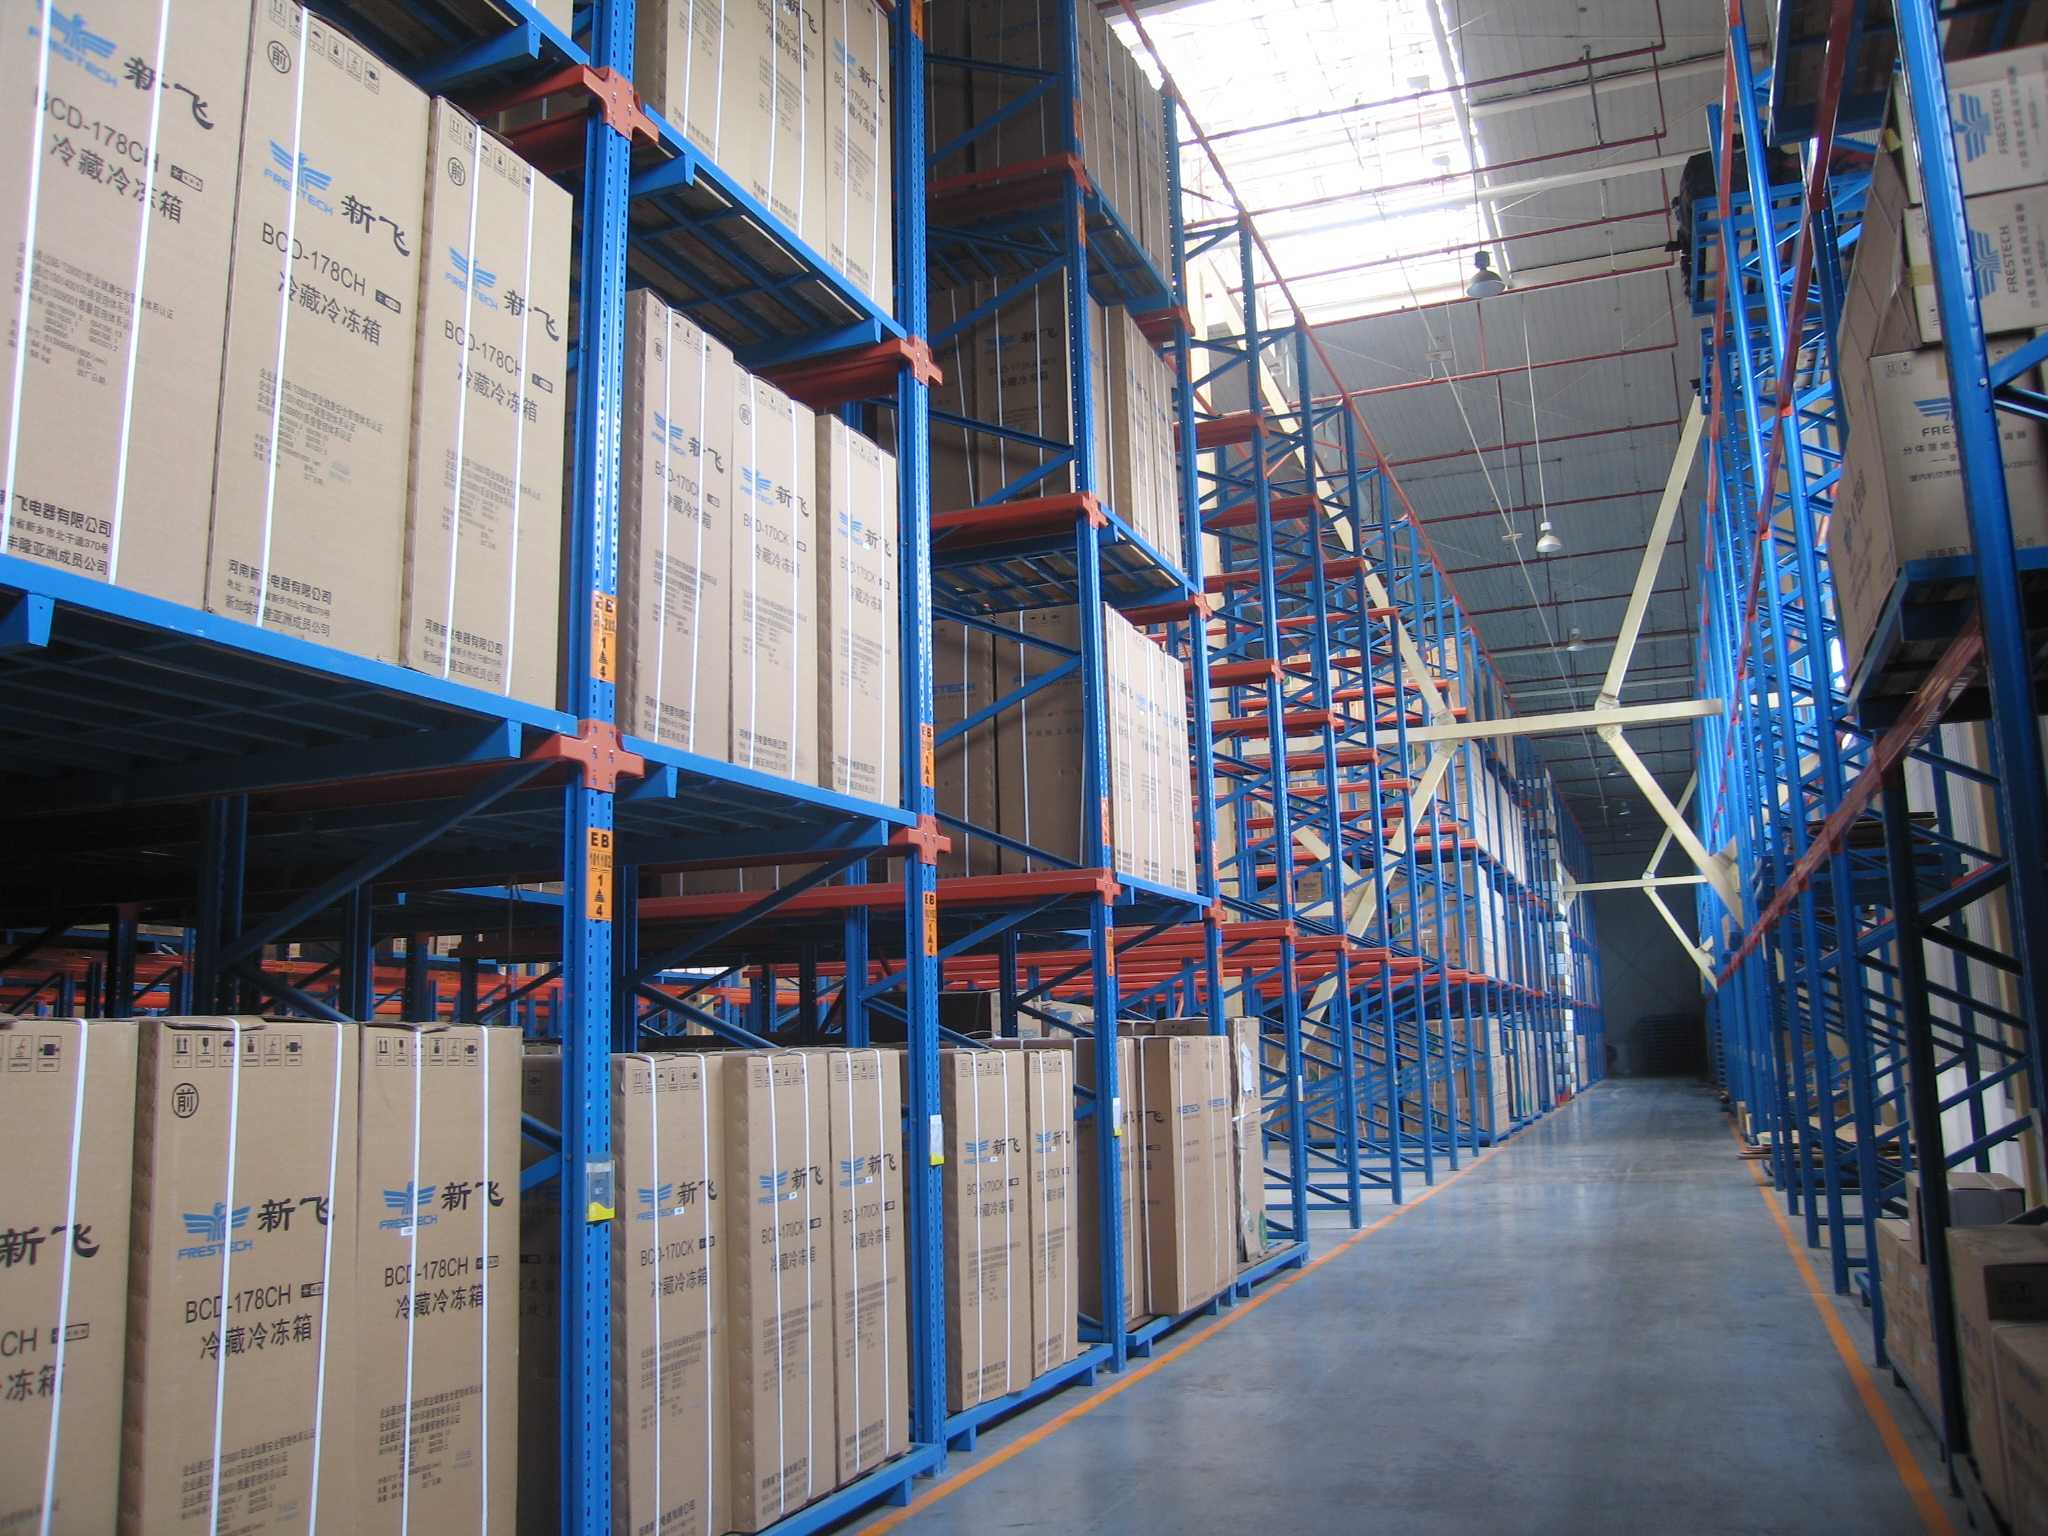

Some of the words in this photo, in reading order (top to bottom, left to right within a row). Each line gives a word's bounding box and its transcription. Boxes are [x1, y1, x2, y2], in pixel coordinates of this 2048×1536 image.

[1990, 87, 2008, 155] FRESTECH
[341, 195, 410, 257] 新飞
[1998, 225, 2018, 293] FRESTECH
[504, 290, 560, 342] 新飞
[228, 559, 332, 605] 河南新电器有限公司
[591, 832, 609, 848] EB
[596, 904, 603, 916] 4
[791, 1166, 823, 1190] 新飞
[867, 1153, 896, 1174] 新飞
[442, 1181, 504, 1211] 新飞
[677, 1179, 717, 1206] 新飞
[258, 1196, 336, 1233] 新飞
[0, 1223, 100, 1268] 新飞
[201, 1313, 312, 1360] 冷藏冷冻箱
